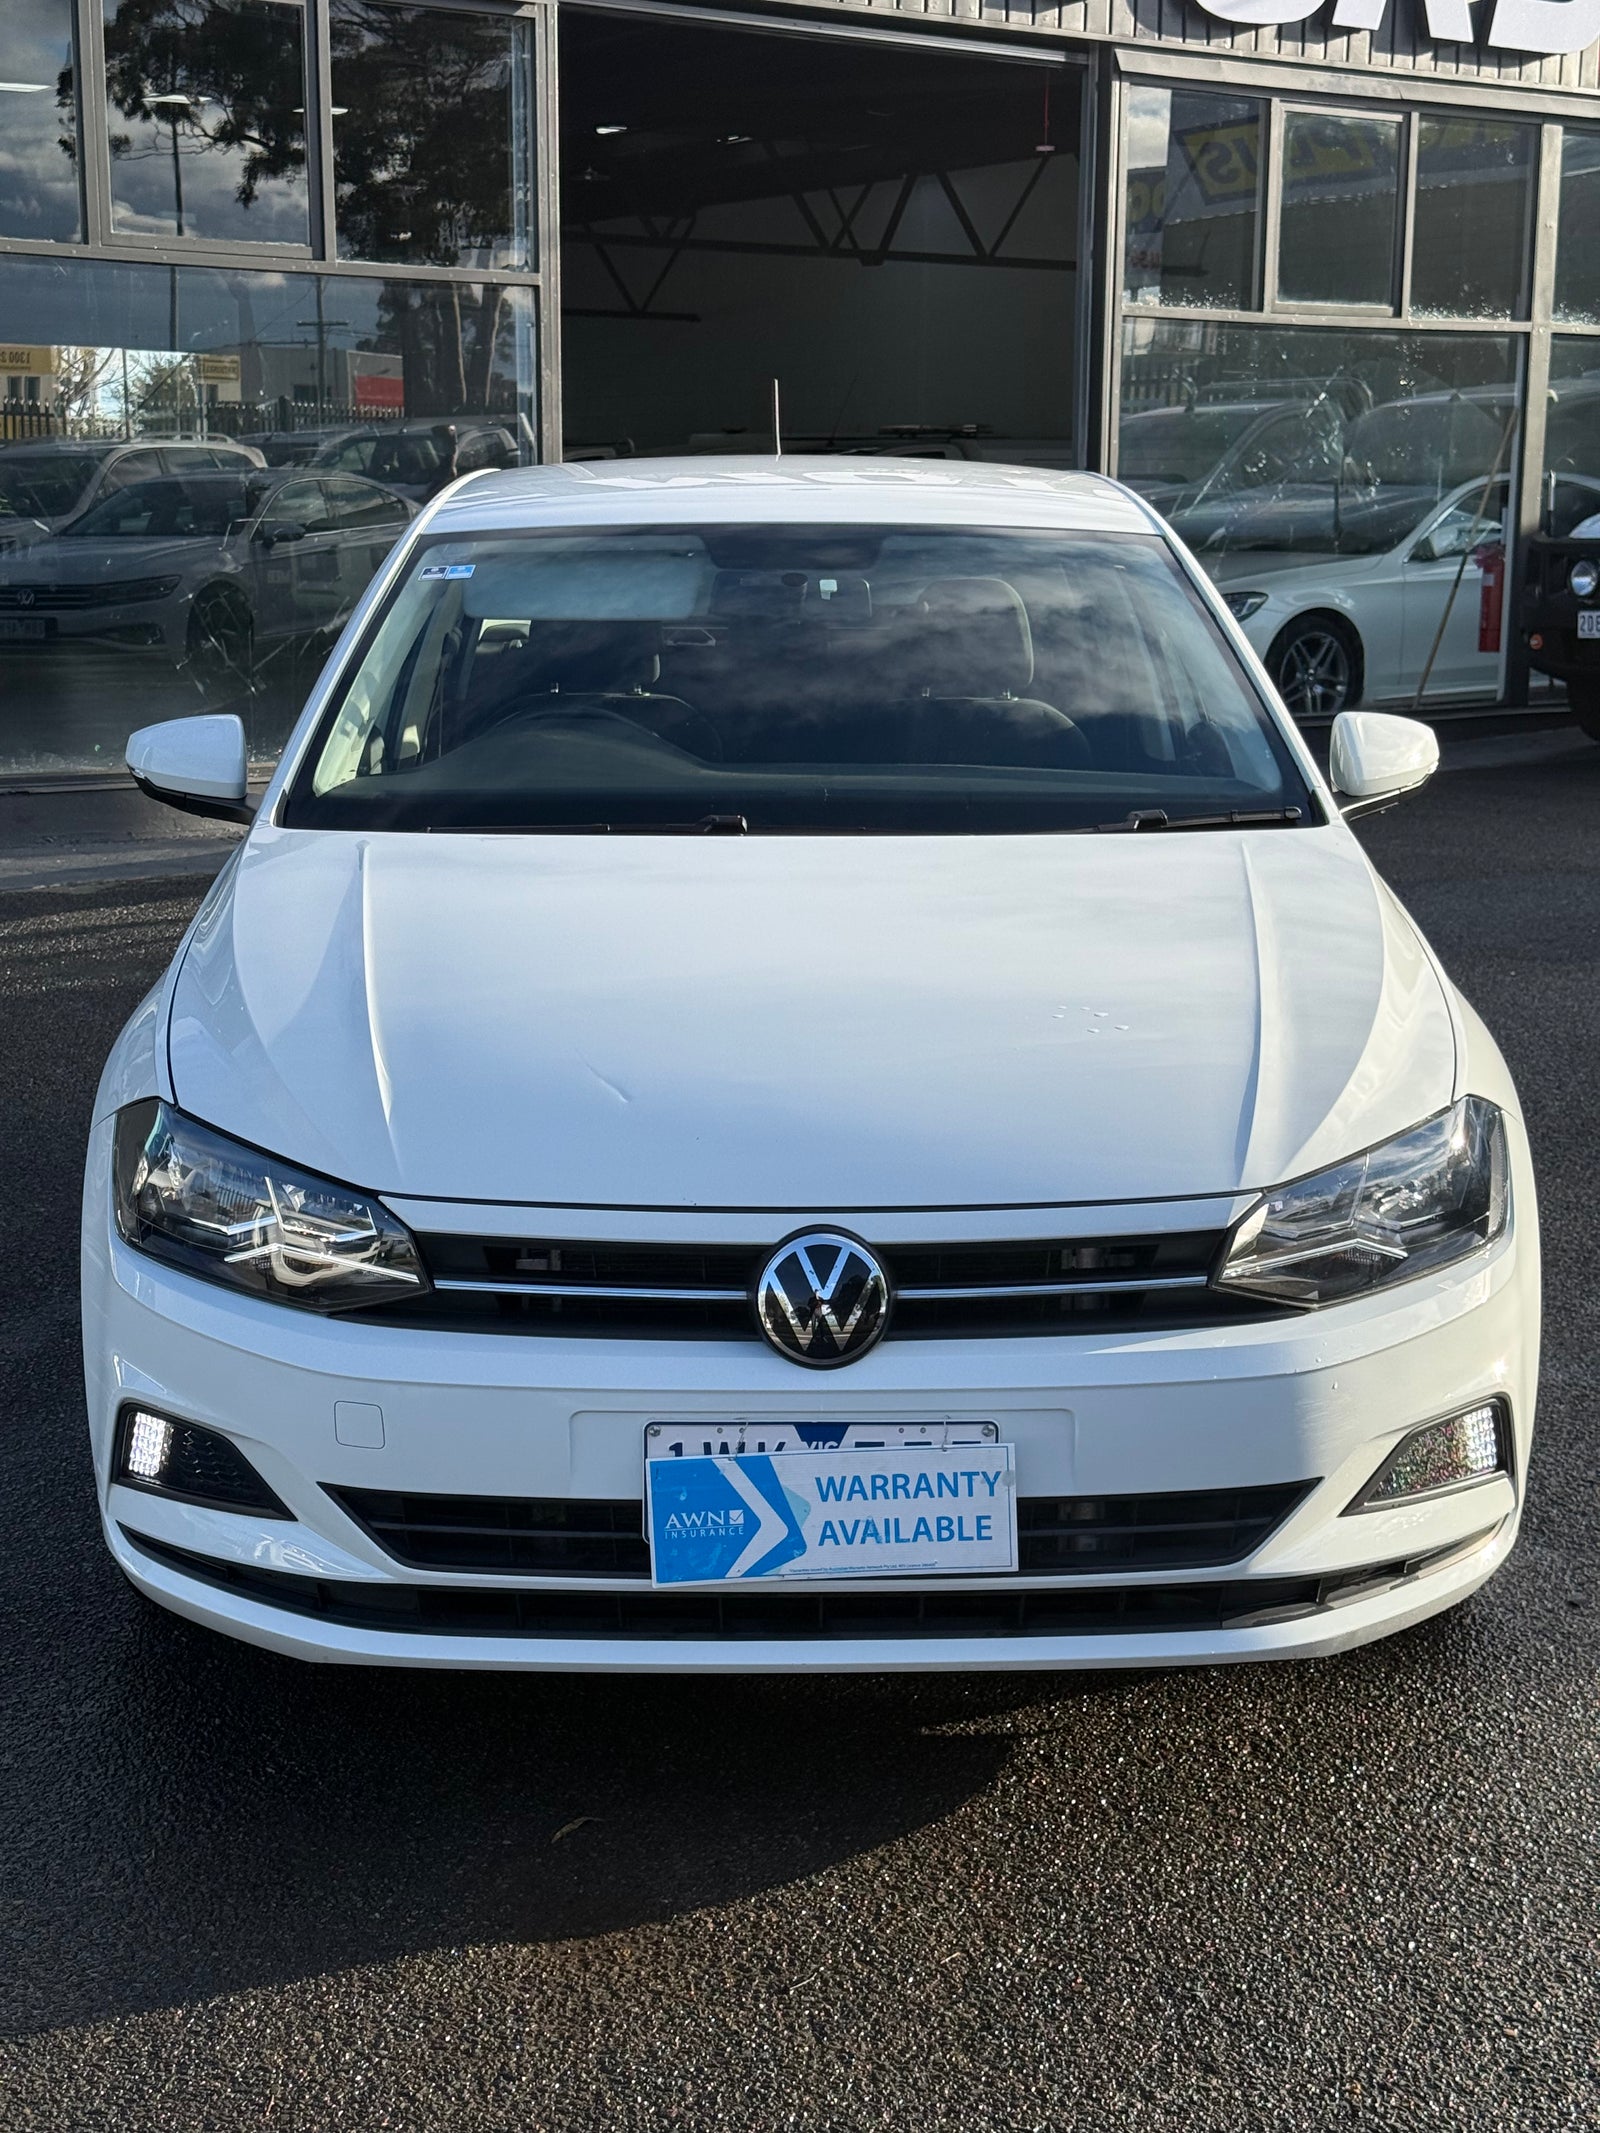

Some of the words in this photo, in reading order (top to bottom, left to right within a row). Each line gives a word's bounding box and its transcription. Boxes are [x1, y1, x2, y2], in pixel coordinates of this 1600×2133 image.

[815, 1471, 1002, 1502] WARRANTY
[665, 1510, 725, 1529] AWN
[818, 1515, 993, 1546] AVAILABLE
[664, 1527, 745, 1540] INSURANCE
